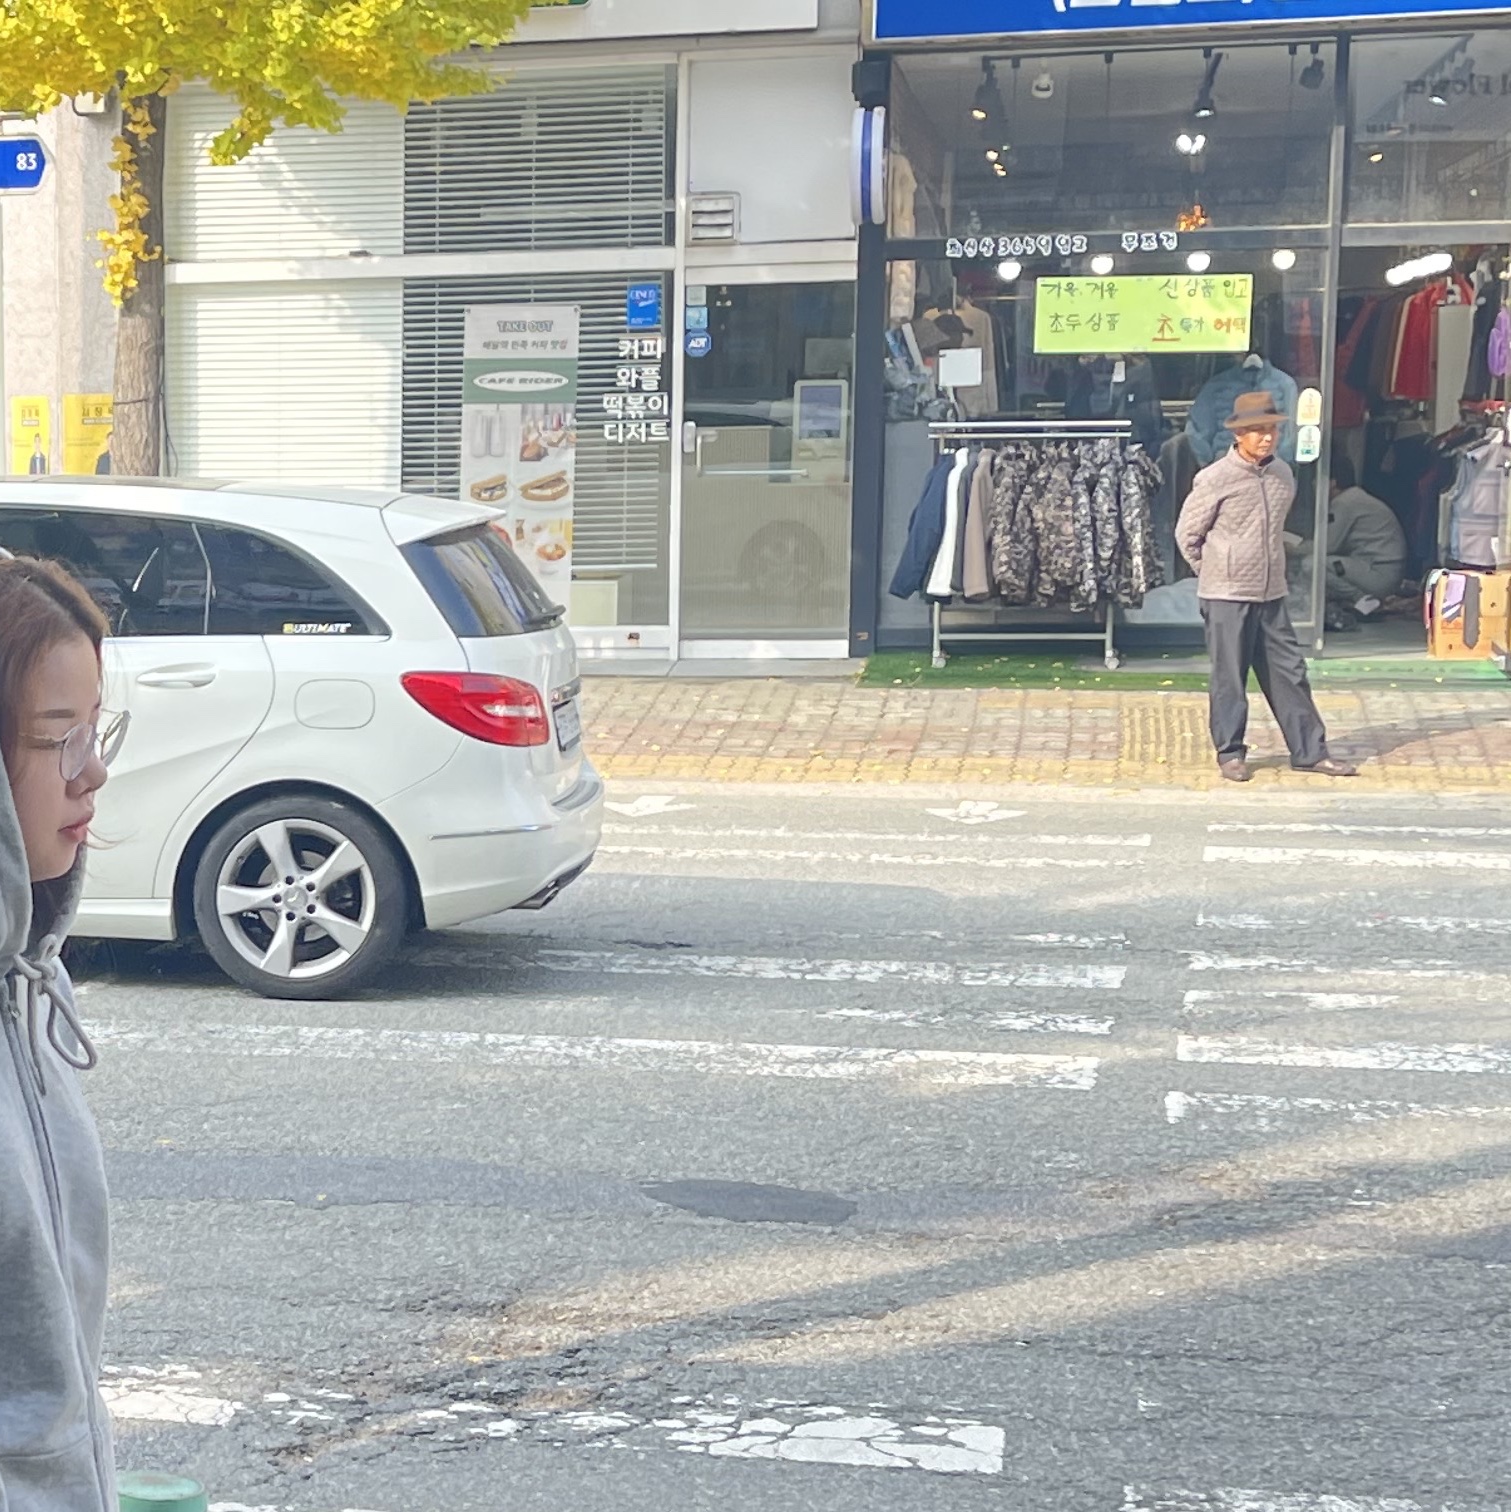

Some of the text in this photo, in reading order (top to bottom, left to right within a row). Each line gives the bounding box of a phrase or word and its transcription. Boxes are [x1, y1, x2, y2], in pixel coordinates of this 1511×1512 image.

[16, 152, 37, 171] 83
[497, 320, 553, 333] TAKE OUT
[618, 338, 662, 359] 커피
[688, 337, 707, 348] ADT
[478, 377, 563, 385] CAFE RIDER
[616, 367, 661, 391] 와플
[603, 394, 669, 419] 떡볶이
[604, 422, 670, 443] 디저트
